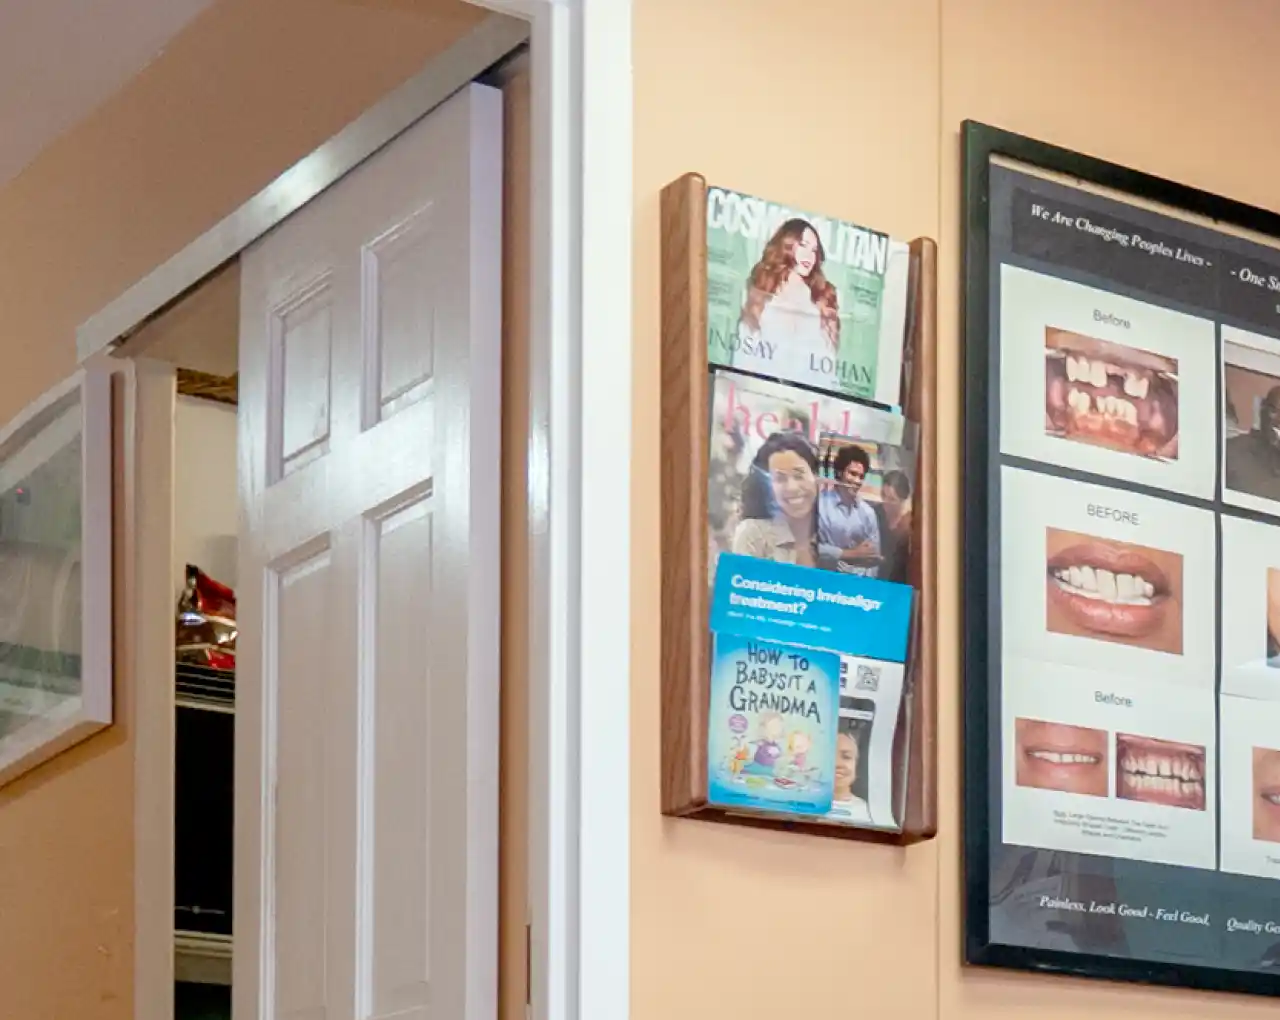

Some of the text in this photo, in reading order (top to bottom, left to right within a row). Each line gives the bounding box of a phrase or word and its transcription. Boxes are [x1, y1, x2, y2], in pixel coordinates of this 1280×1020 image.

[708, 187, 888, 275] COSMOLITAN
[1031, 203, 1050, 220] We
[1051, 211, 1073, 227] Are
[1075, 217, 1130, 247] Changing
[1131, 234, 1173, 258] Peoples
[1175, 248, 1204, 267] Lives
[1239, 268, 1266, 287] One
[1093, 309, 1131, 329] Before
[709, 327, 873, 385] INDSAY LOHAN
[1087, 503, 1140, 526] BEFORE
[729, 592, 809, 615] treatment?
[731, 574, 883, 612] Considering Invisalign
[747, 642, 809, 672] HOW TO
[735, 661, 816, 694] BABYSIT A
[729, 686, 821, 724] GRANDMA
[1094, 690, 1133, 708] Before
[1089, 901, 1116, 915] Look
[1118, 904, 1149, 918] Good
[1155, 908, 1179, 922] Feel
[1226, 917, 1263, 934] Quality
